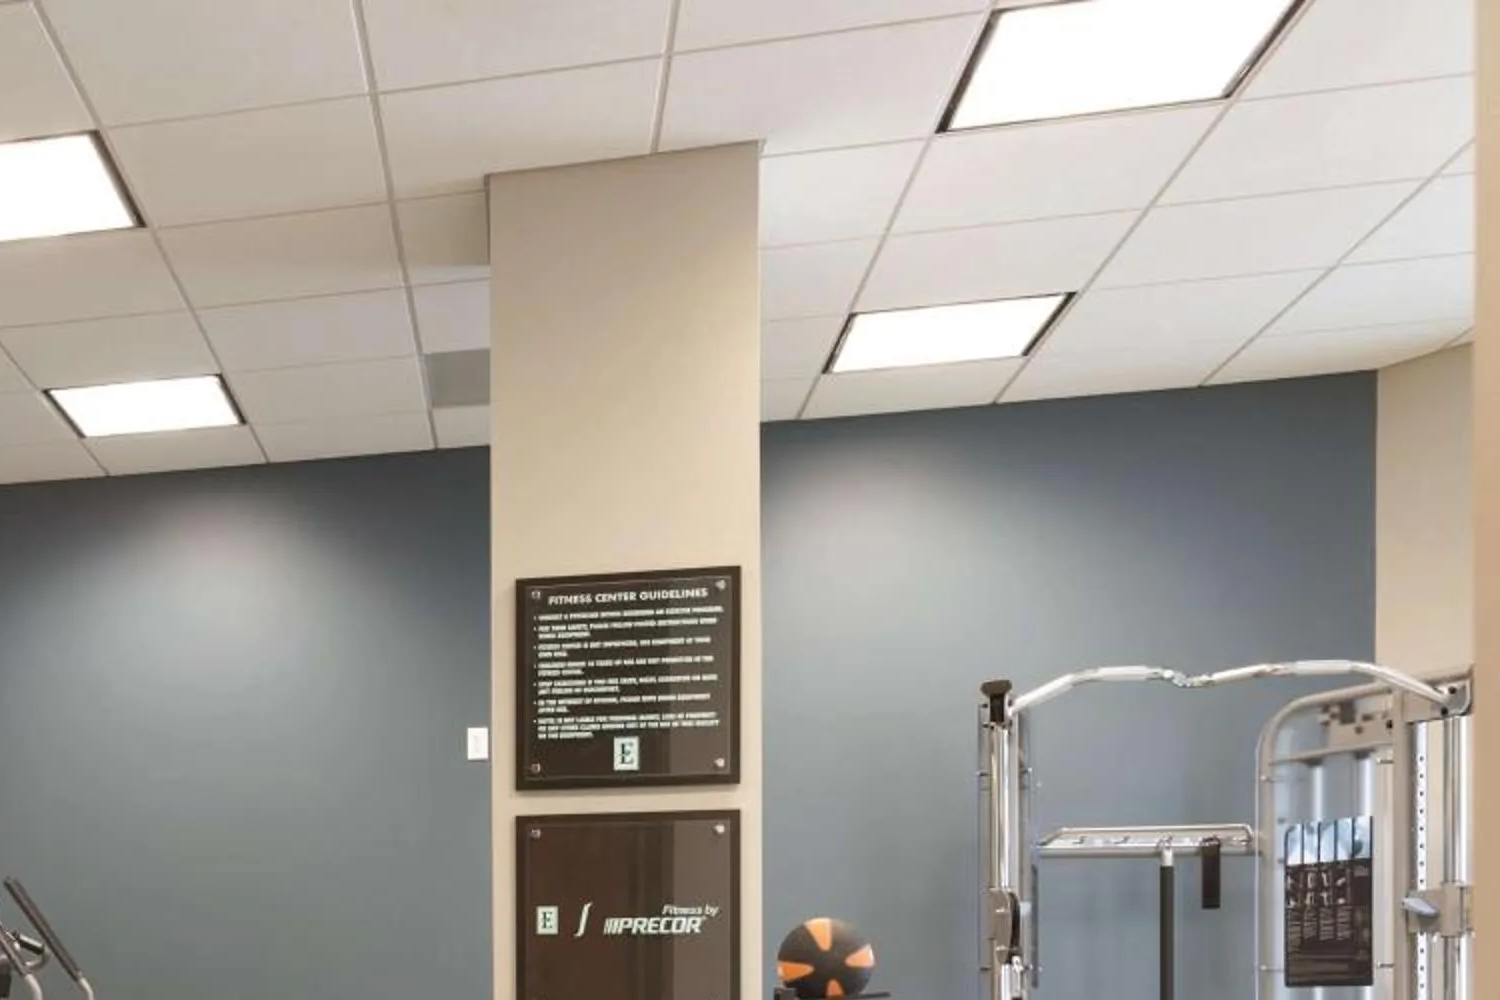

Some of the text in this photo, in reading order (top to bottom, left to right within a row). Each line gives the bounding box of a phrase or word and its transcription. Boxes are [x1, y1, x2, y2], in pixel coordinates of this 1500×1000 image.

[548, 588, 708, 605] FITNESS CENTER GUIDELINES
[705, 904, 719, 917] by
[615, 917, 701, 935] PRECOR
